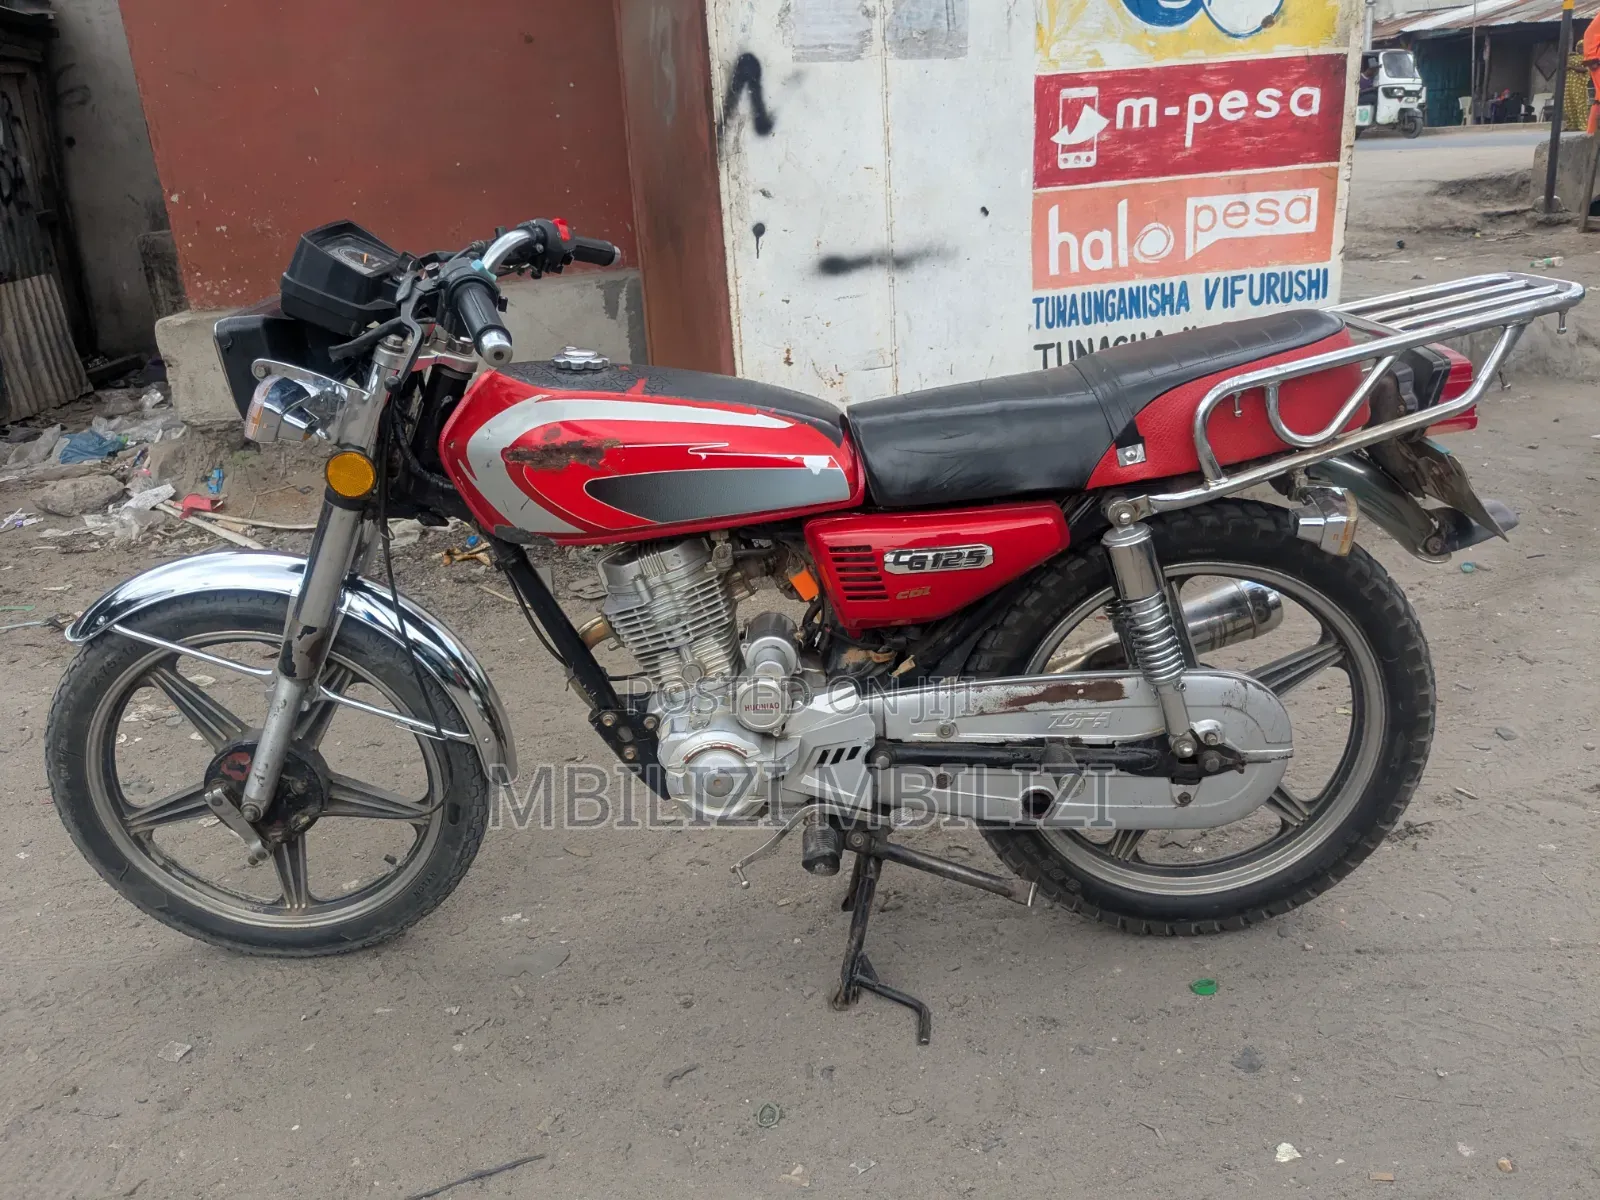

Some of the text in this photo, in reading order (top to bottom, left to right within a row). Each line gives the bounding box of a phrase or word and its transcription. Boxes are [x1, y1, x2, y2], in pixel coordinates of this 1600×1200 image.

[1115, 86, 1321, 148] m-pesa
[1193, 195, 1312, 255] pesa
[1032, 267, 1329, 330] TUNAUNGANISHA VIFURUSHI
[412, 871, 438, 898] NYLON
